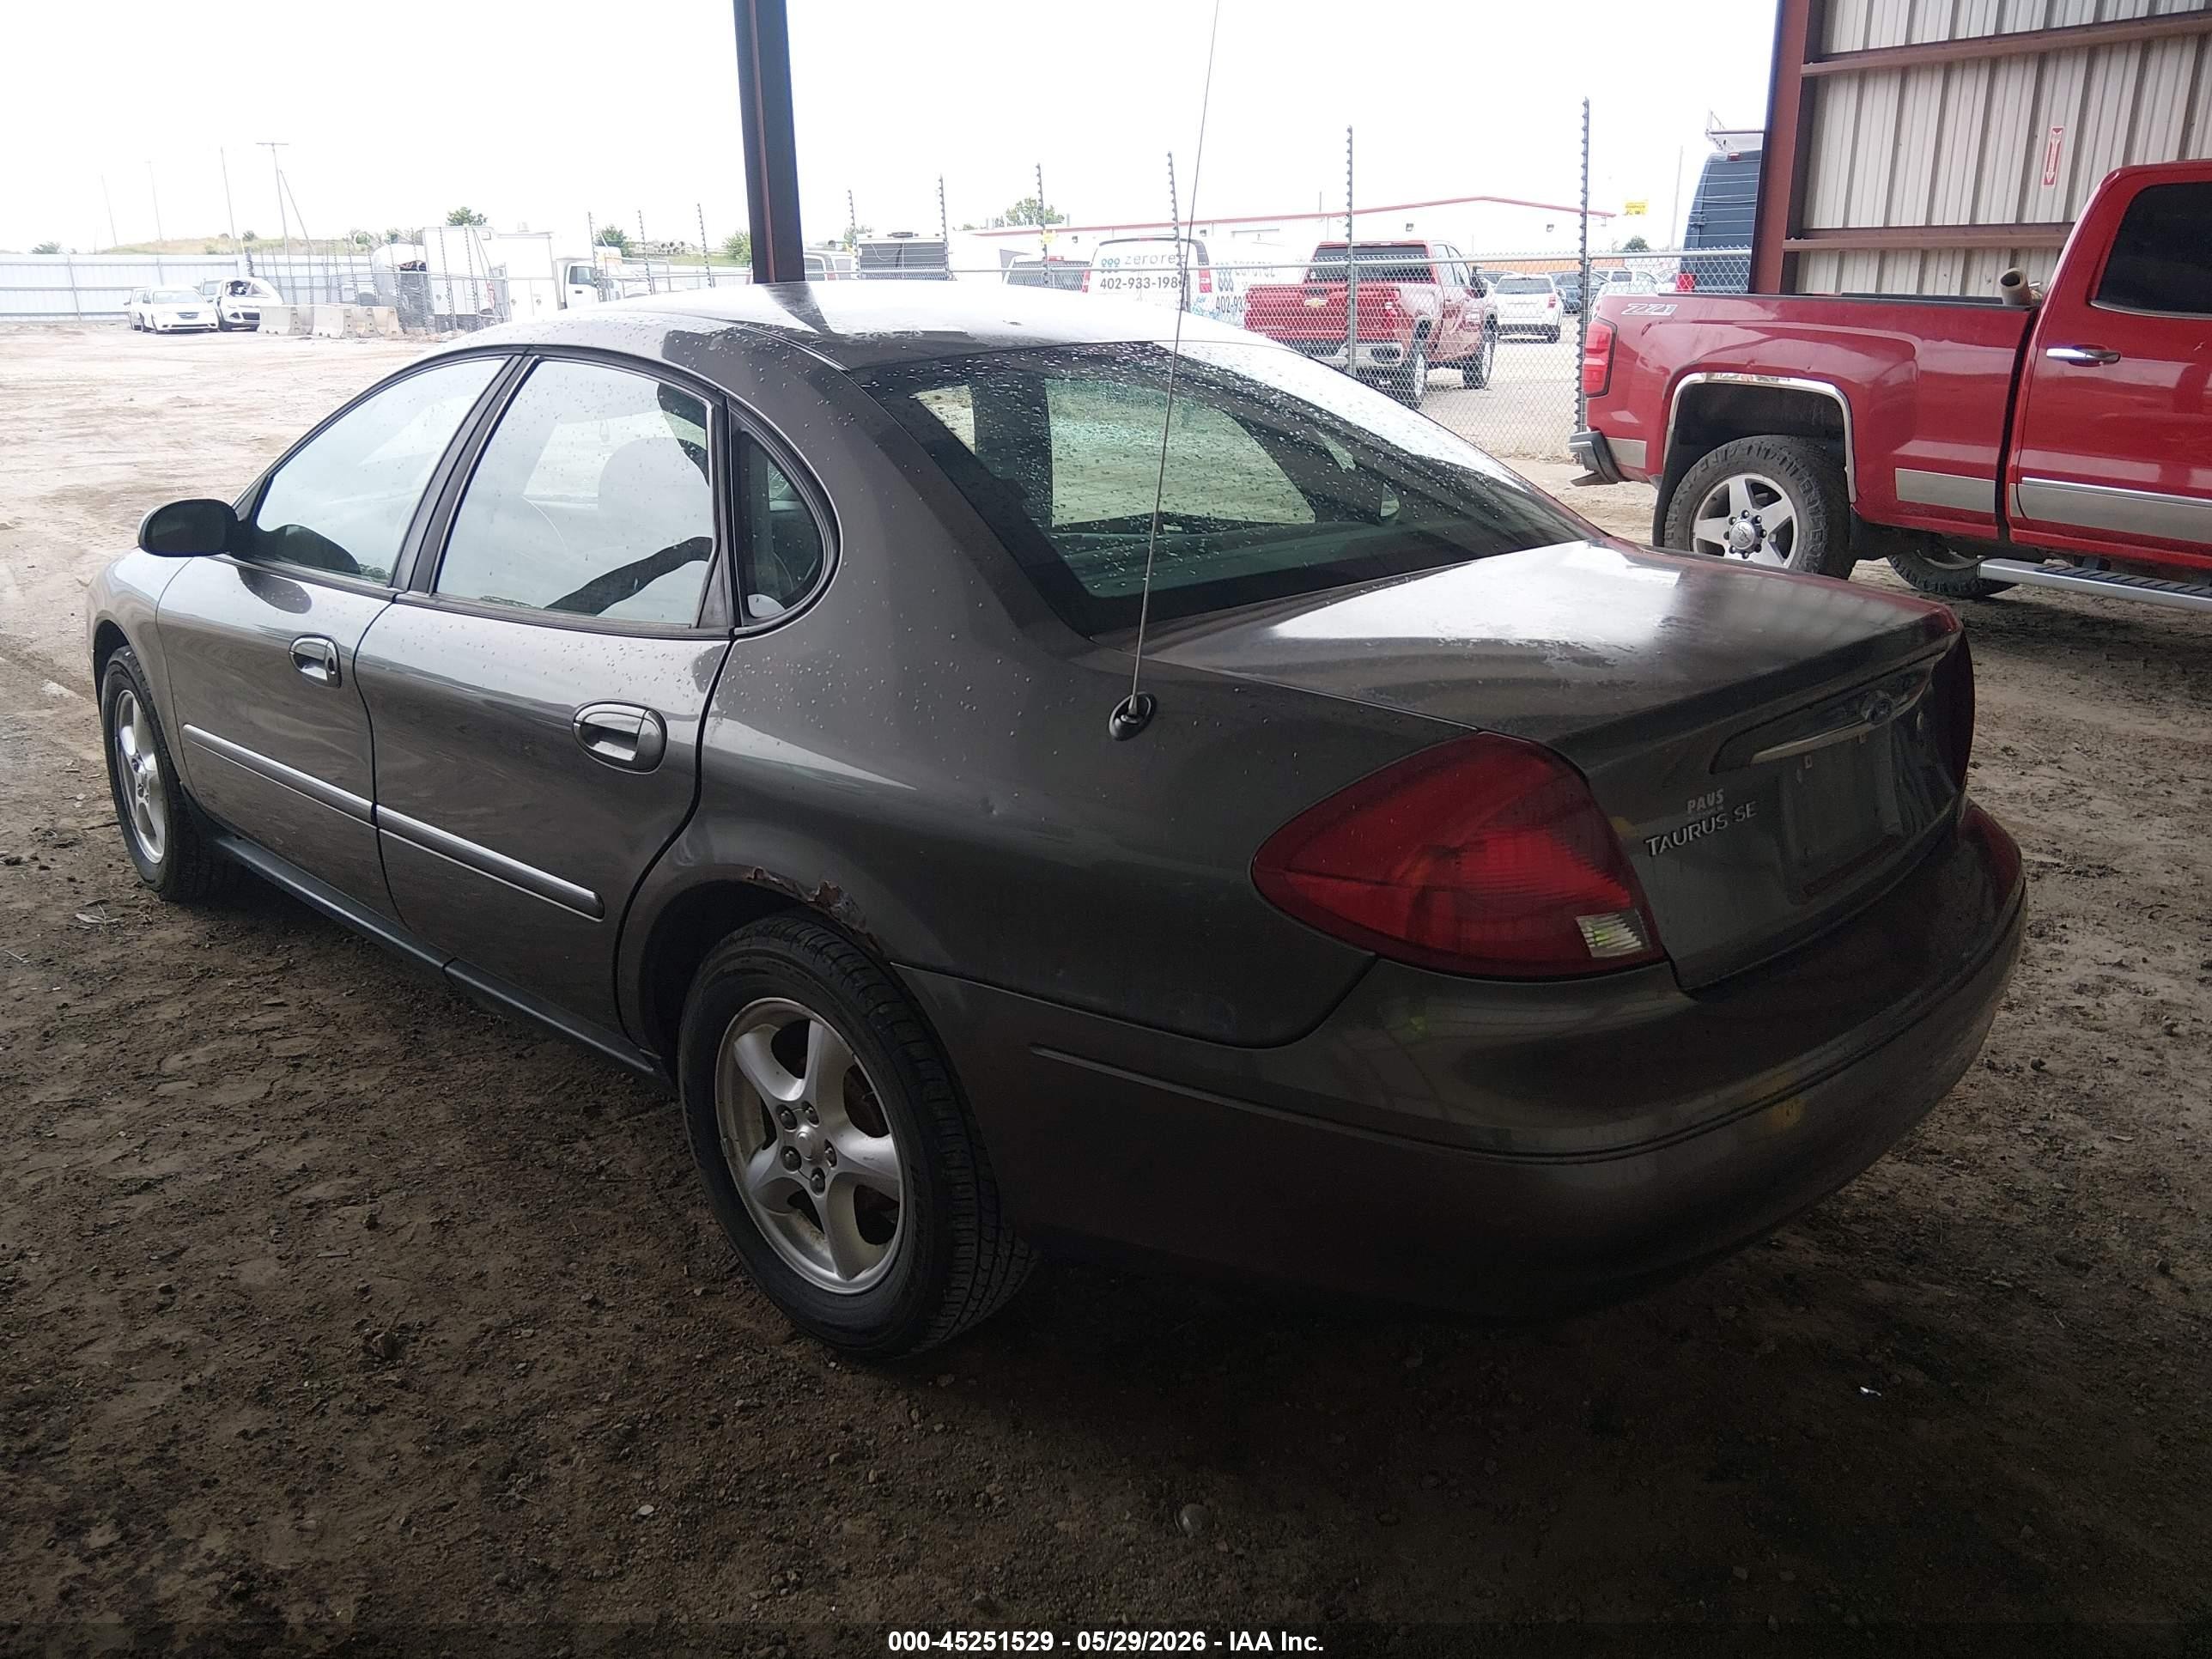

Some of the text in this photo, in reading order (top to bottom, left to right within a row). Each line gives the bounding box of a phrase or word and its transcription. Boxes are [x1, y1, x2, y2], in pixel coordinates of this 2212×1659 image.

[1100, 276, 1183, 289] 402-933-198
[1644, 812, 1729, 857] TAURUS
[1733, 800, 1758, 823] SE
